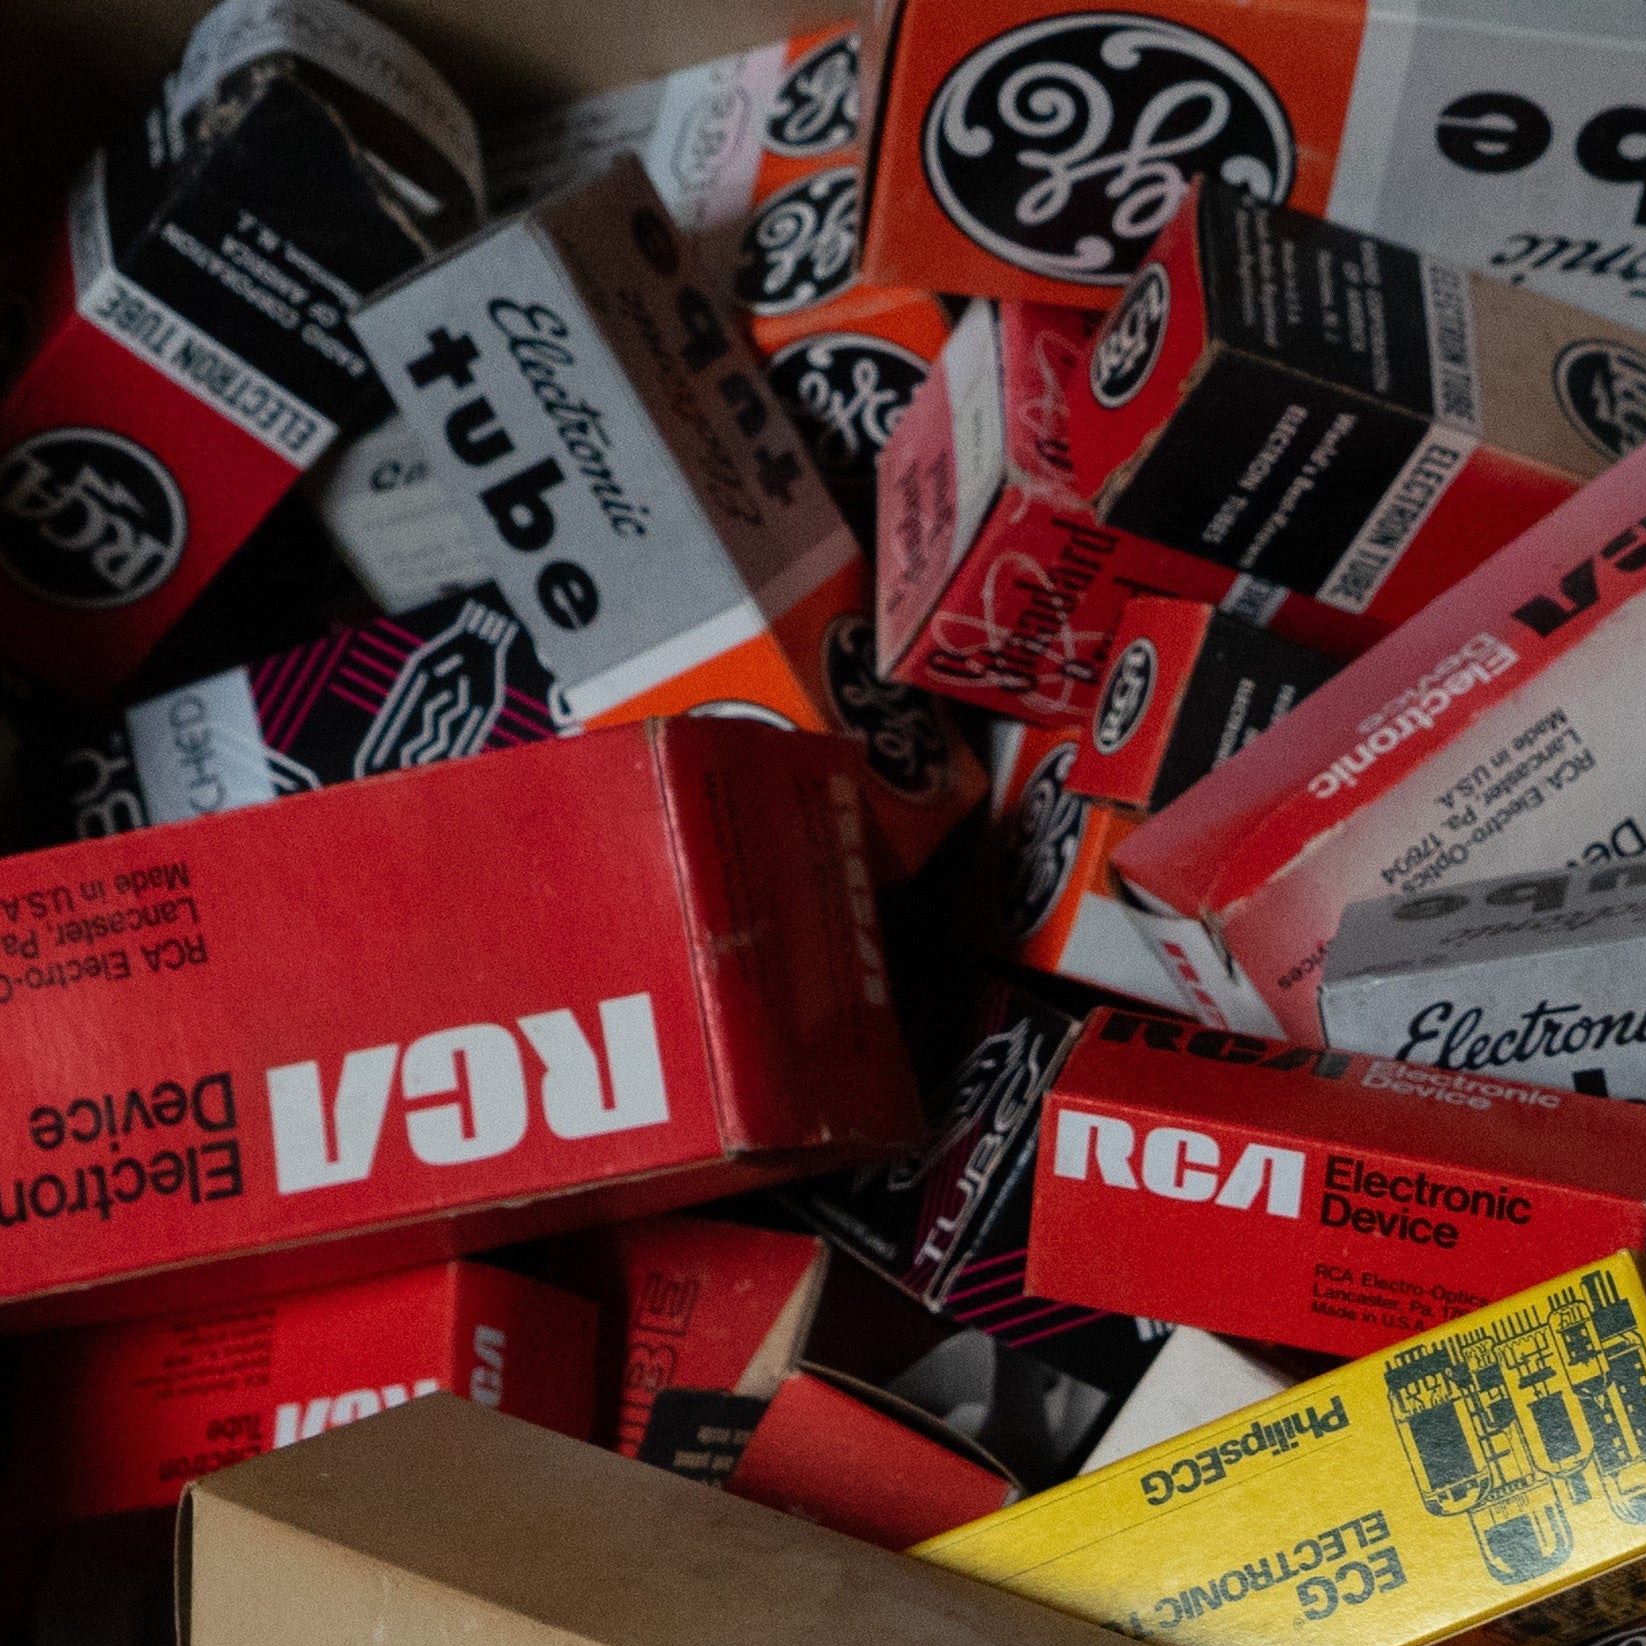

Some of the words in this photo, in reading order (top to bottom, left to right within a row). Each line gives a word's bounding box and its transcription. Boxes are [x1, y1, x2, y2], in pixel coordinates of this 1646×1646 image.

[100, 285, 176, 356] TUBE
[174, 338, 321, 453] ELECTRON
[488, 297, 649, 540] Electronic
[408, 326, 600, 632] tube
[1374, 443, 1460, 542] ELECTRON
[1331, 539, 1389, 601] TUBE
[1308, 632, 1520, 802] Electronic
[1513, 707, 1567, 749] Made
[1491, 750, 1510, 768] in
[1546, 750, 1595, 789] RCA
[80, 877, 103, 896] in
[116, 862, 190, 894] Made
[48, 896, 198, 949] Lancaster,
[143, 933, 209, 973] RCA
[30, 1071, 237, 1151] Device
[266, 992, 670, 1196] RCA
[1054, 1109, 1306, 1219] RCA
[1324, 1155, 1533, 1226] Electronic
[1320, 1193, 1459, 1249] Device
[1314, 1264, 1355, 1285] RCA
[1311, 1302, 1355, 1323] Made
[1362, 1309, 1375, 1325] in
[1140, 1395, 1351, 1506] PhilipsECG
[1145, 1510, 1392, 1630] ELECTRONIC
[1298, 1546, 1409, 1622] ECG
